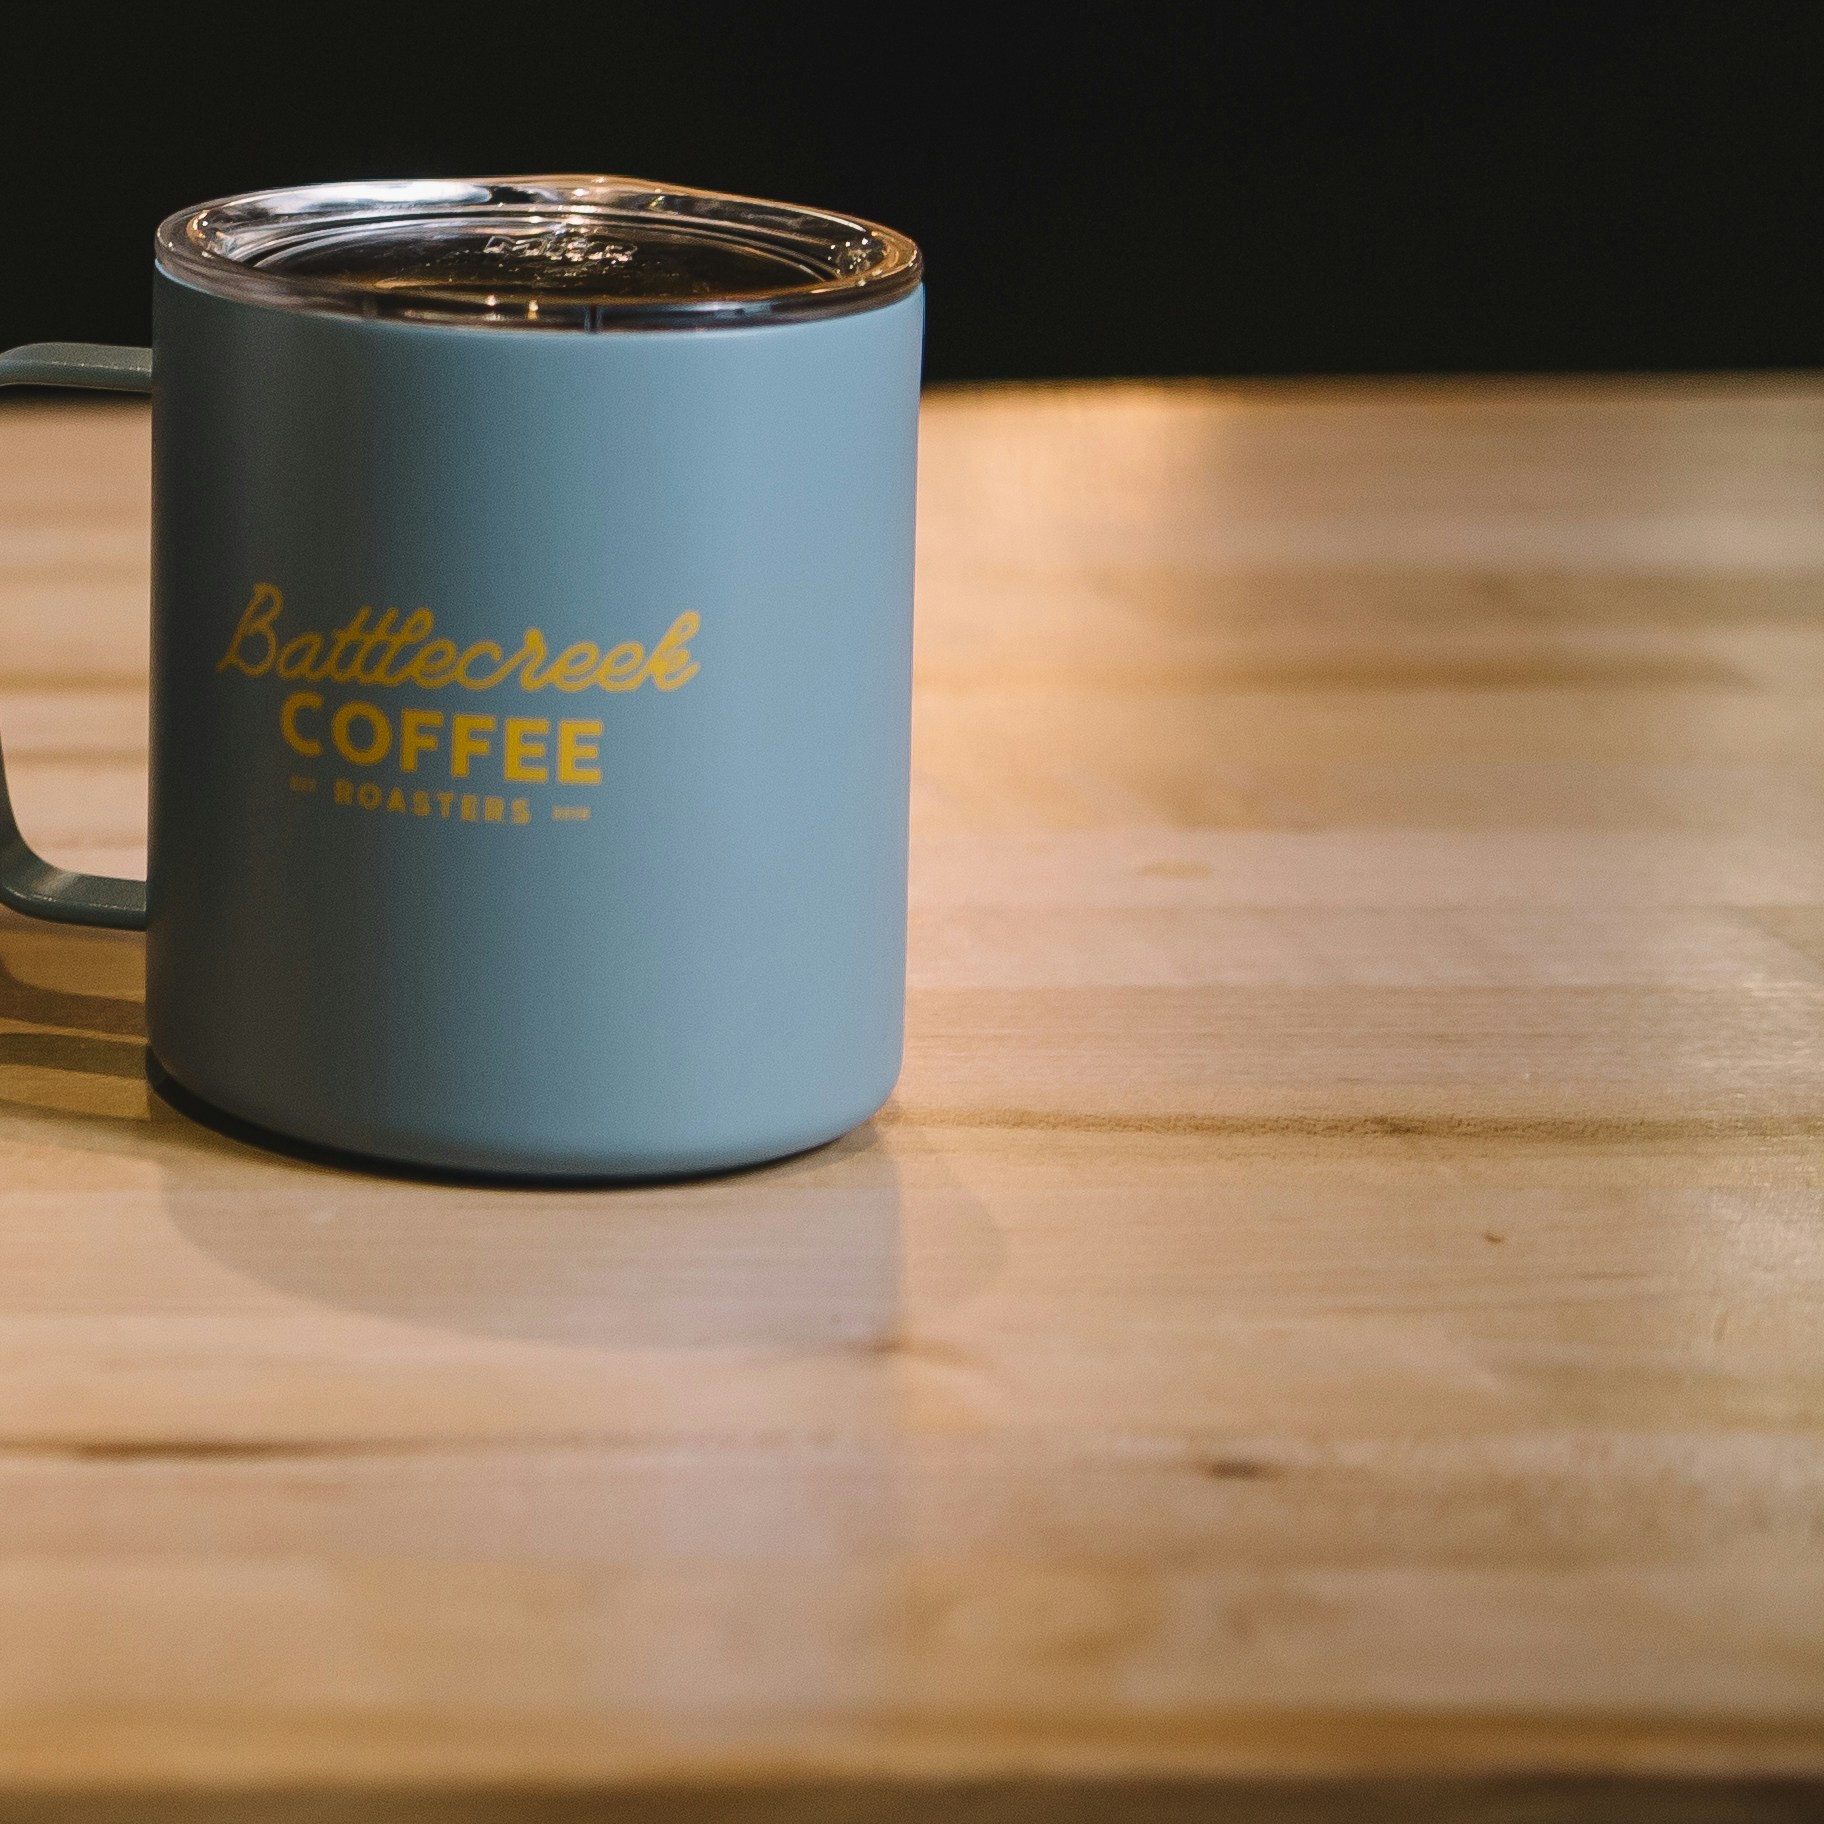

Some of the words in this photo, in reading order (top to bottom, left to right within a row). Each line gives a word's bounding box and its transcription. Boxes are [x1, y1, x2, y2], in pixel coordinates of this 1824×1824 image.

[216, 582, 702, 692] Battlecreek
[279, 691, 604, 785] COFFEE
[333, 778, 532, 825] ROASTERS
